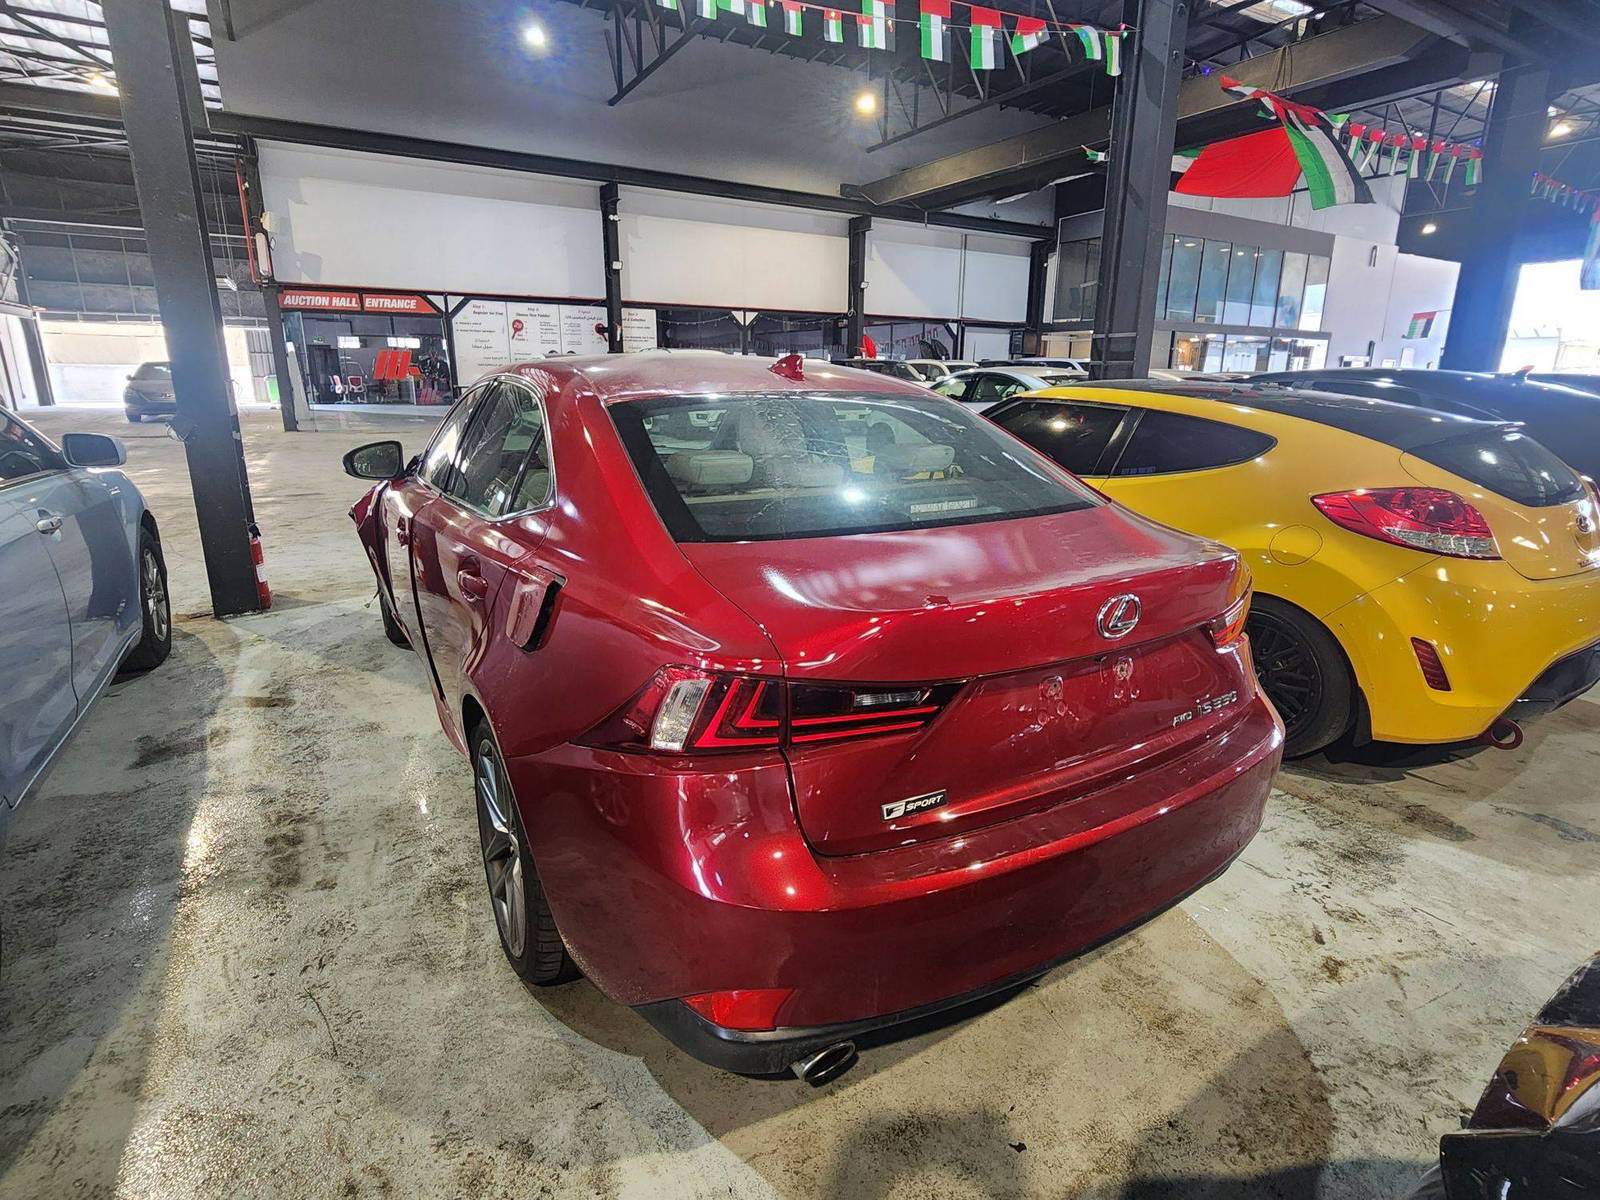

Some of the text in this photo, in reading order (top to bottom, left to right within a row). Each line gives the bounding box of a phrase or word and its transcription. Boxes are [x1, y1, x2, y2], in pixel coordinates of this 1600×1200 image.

[283, 294, 417, 309] AUCTION HALL ENTRANCE
[905, 794, 944, 812] SPORT
